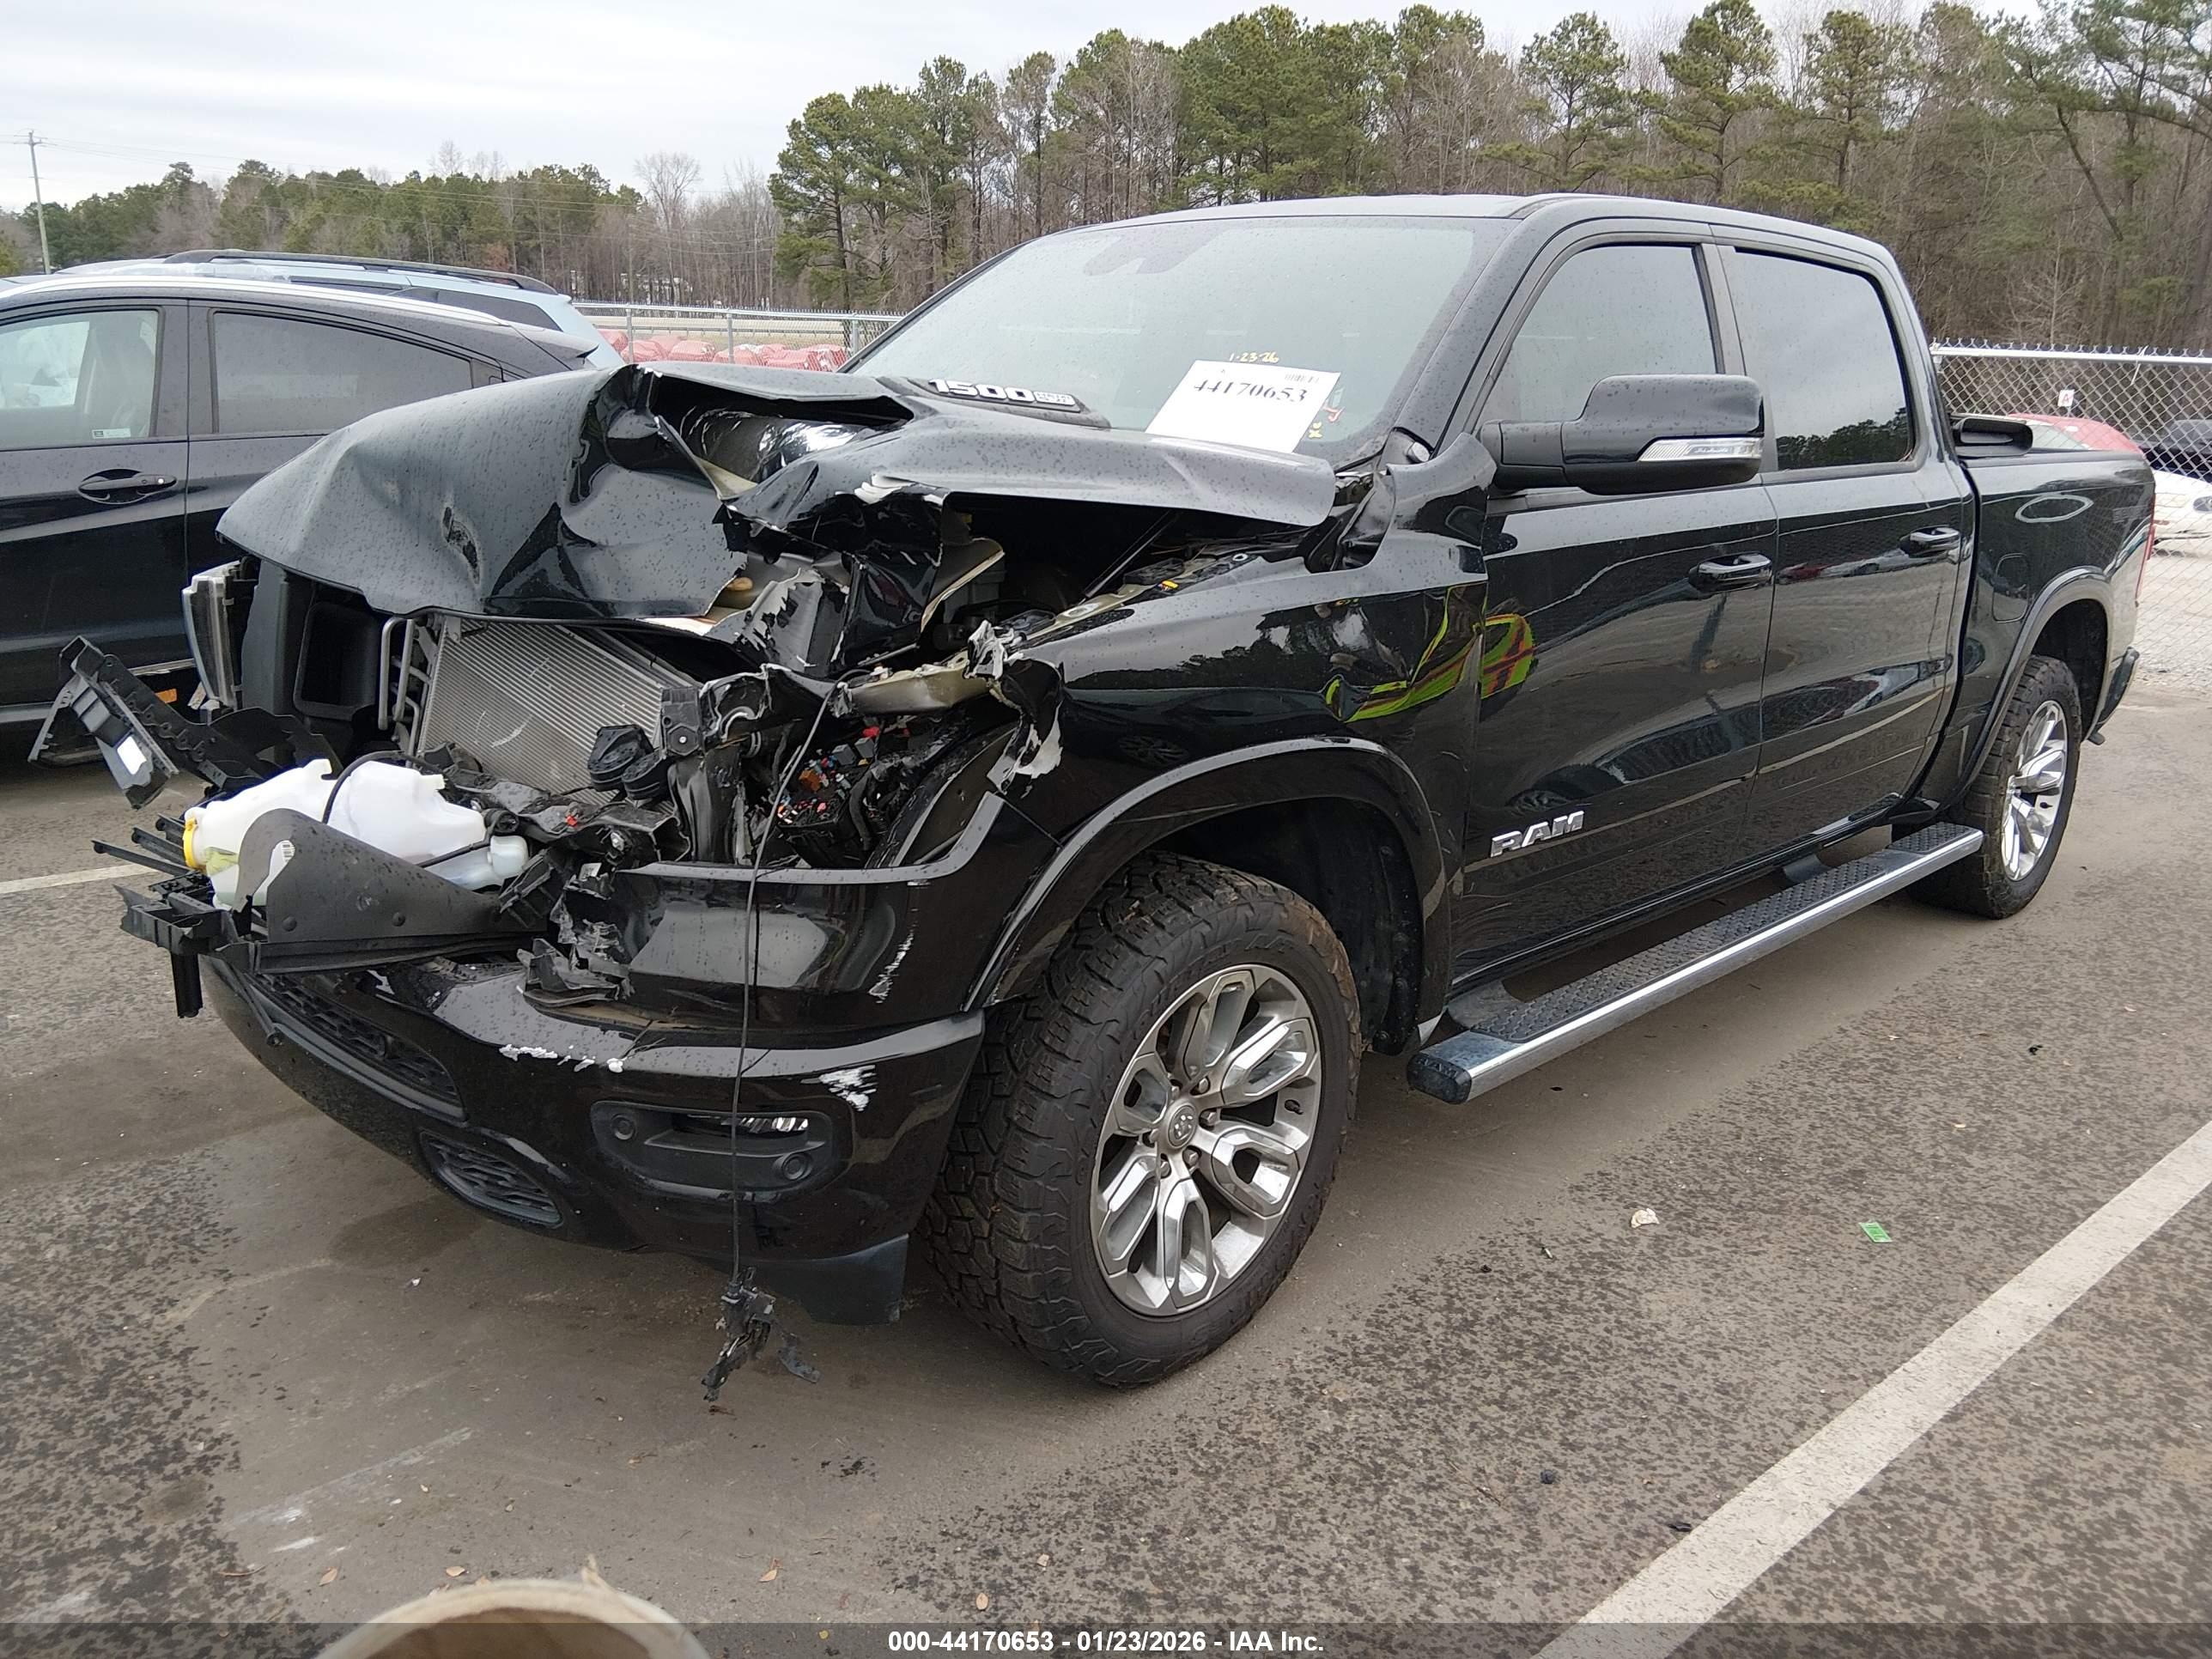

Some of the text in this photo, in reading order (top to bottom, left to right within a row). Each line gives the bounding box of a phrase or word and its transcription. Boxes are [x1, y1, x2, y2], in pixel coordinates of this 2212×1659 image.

[928, 379, 1036, 404] 1500
[1194, 380, 1308, 402] 44170653
[1490, 810, 1585, 858] RAM
